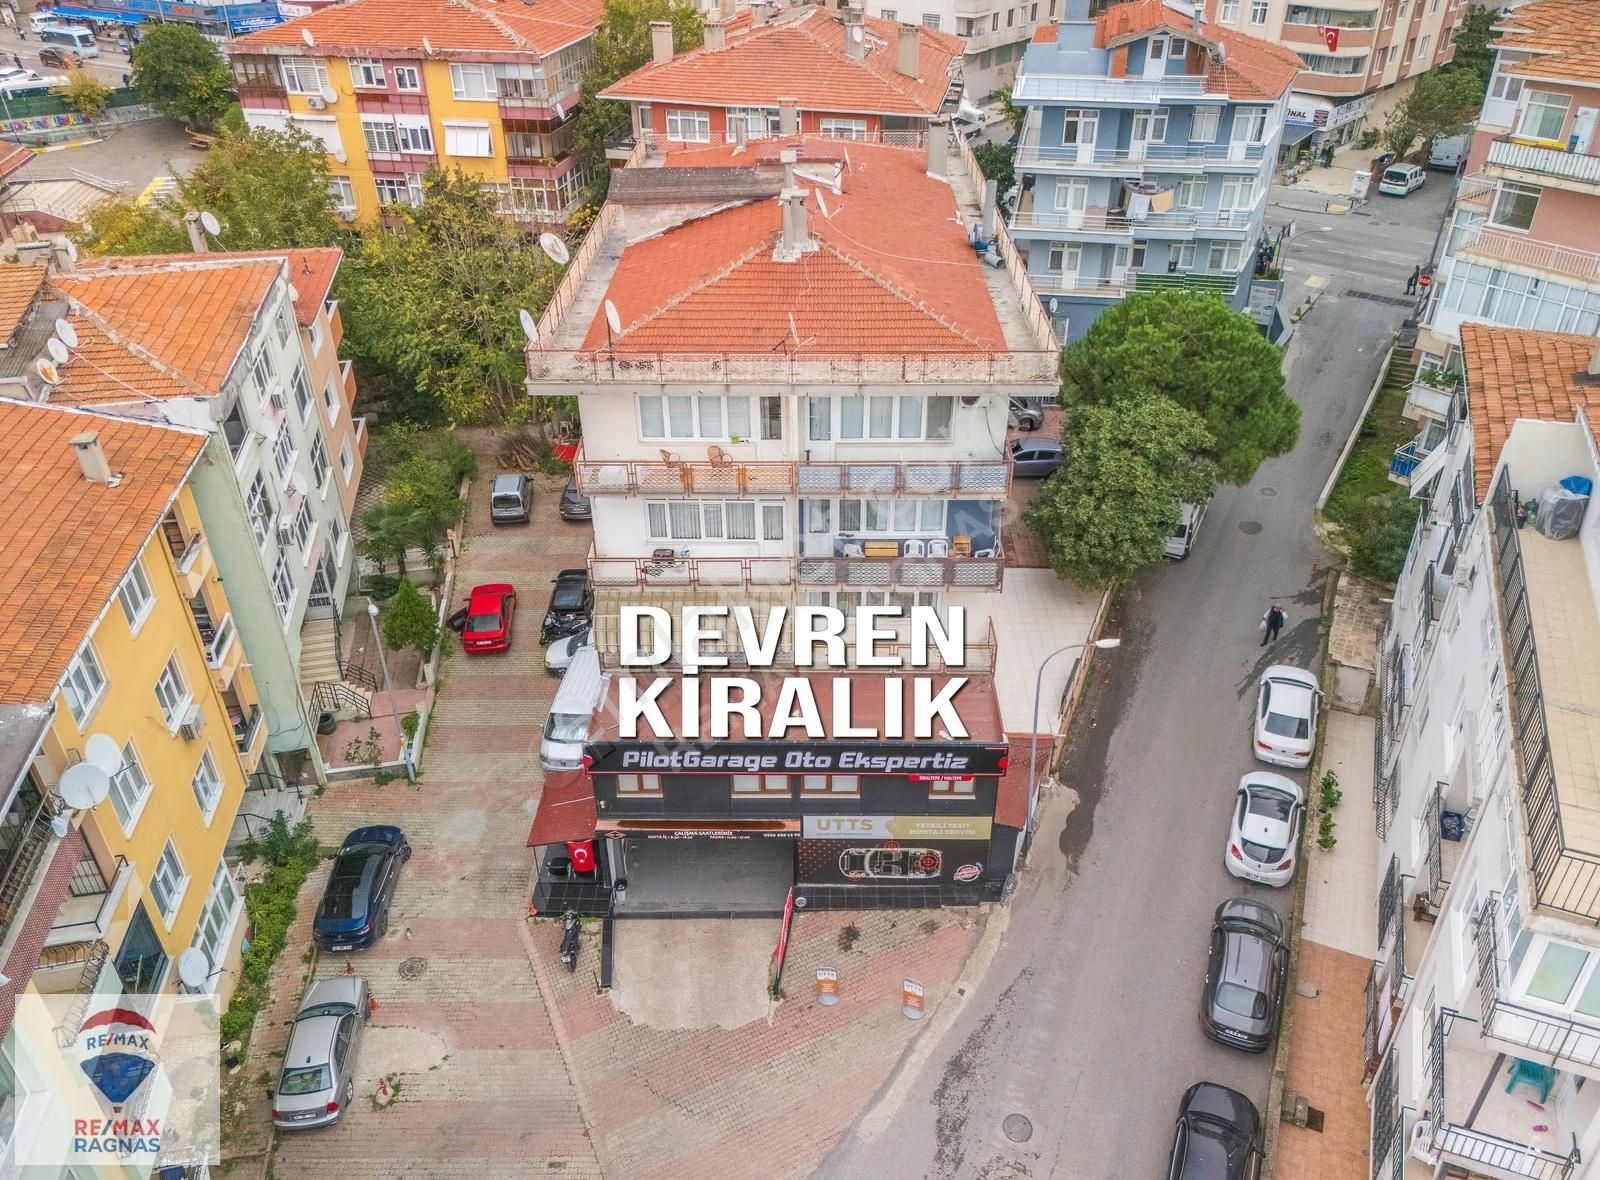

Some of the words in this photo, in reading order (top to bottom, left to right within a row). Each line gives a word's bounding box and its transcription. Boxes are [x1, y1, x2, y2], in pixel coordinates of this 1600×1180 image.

[623, 751, 778, 772] PilotGarage
[784, 751, 832, 768] Oto
[839, 751, 969, 773] Ekspertiz
[816, 818, 873, 831] UTTS
